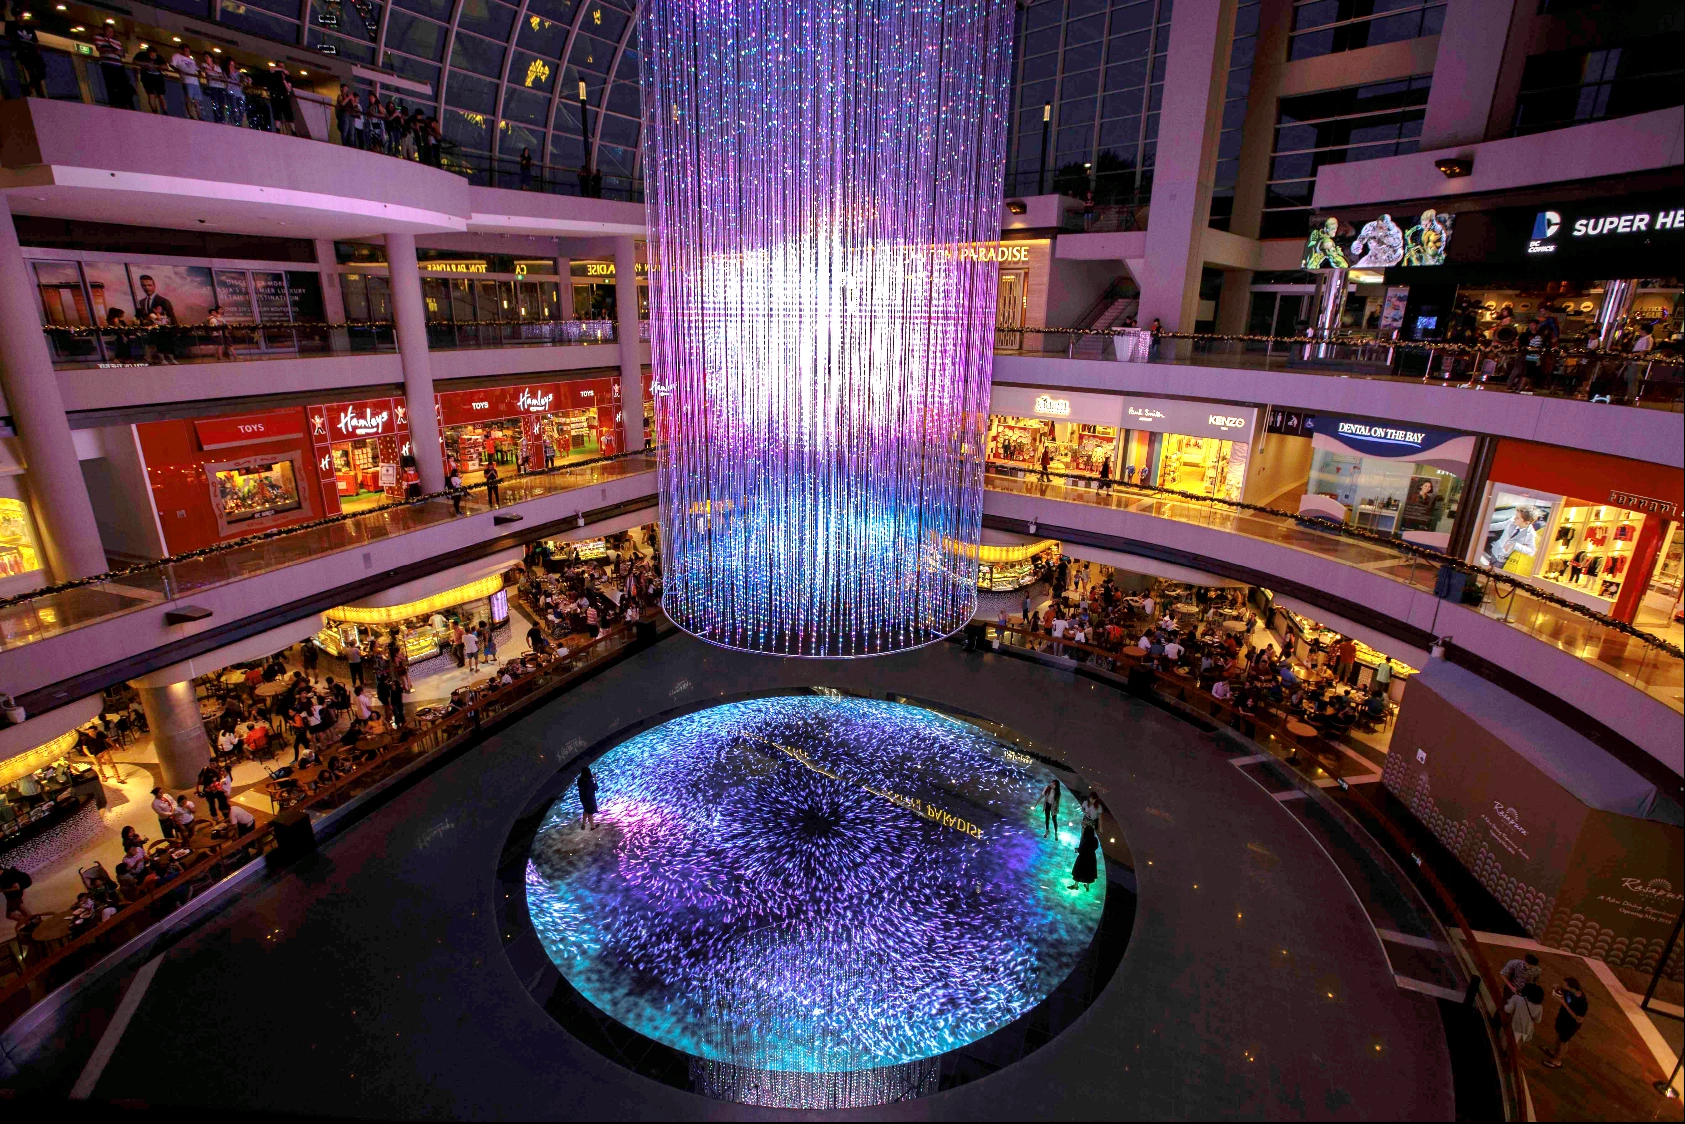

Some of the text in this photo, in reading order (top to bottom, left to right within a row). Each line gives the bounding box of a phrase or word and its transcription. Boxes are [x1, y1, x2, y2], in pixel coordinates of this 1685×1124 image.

[1572, 214, 1650, 236] SUPER
[960, 246, 1030, 262] PARADISE
[517, 388, 553, 411] Hamleys
[580, 390, 594, 398] TOYS
[471, 401, 489, 410] TOYS
[1128, 406, 1143, 416] Paul
[337, 405, 388, 435] Hamleys
[1208, 414, 1245, 428] KENZO
[237, 423, 265, 434] TOYS
[1338, 422, 1426, 443] DENTAL ON THE BAY
